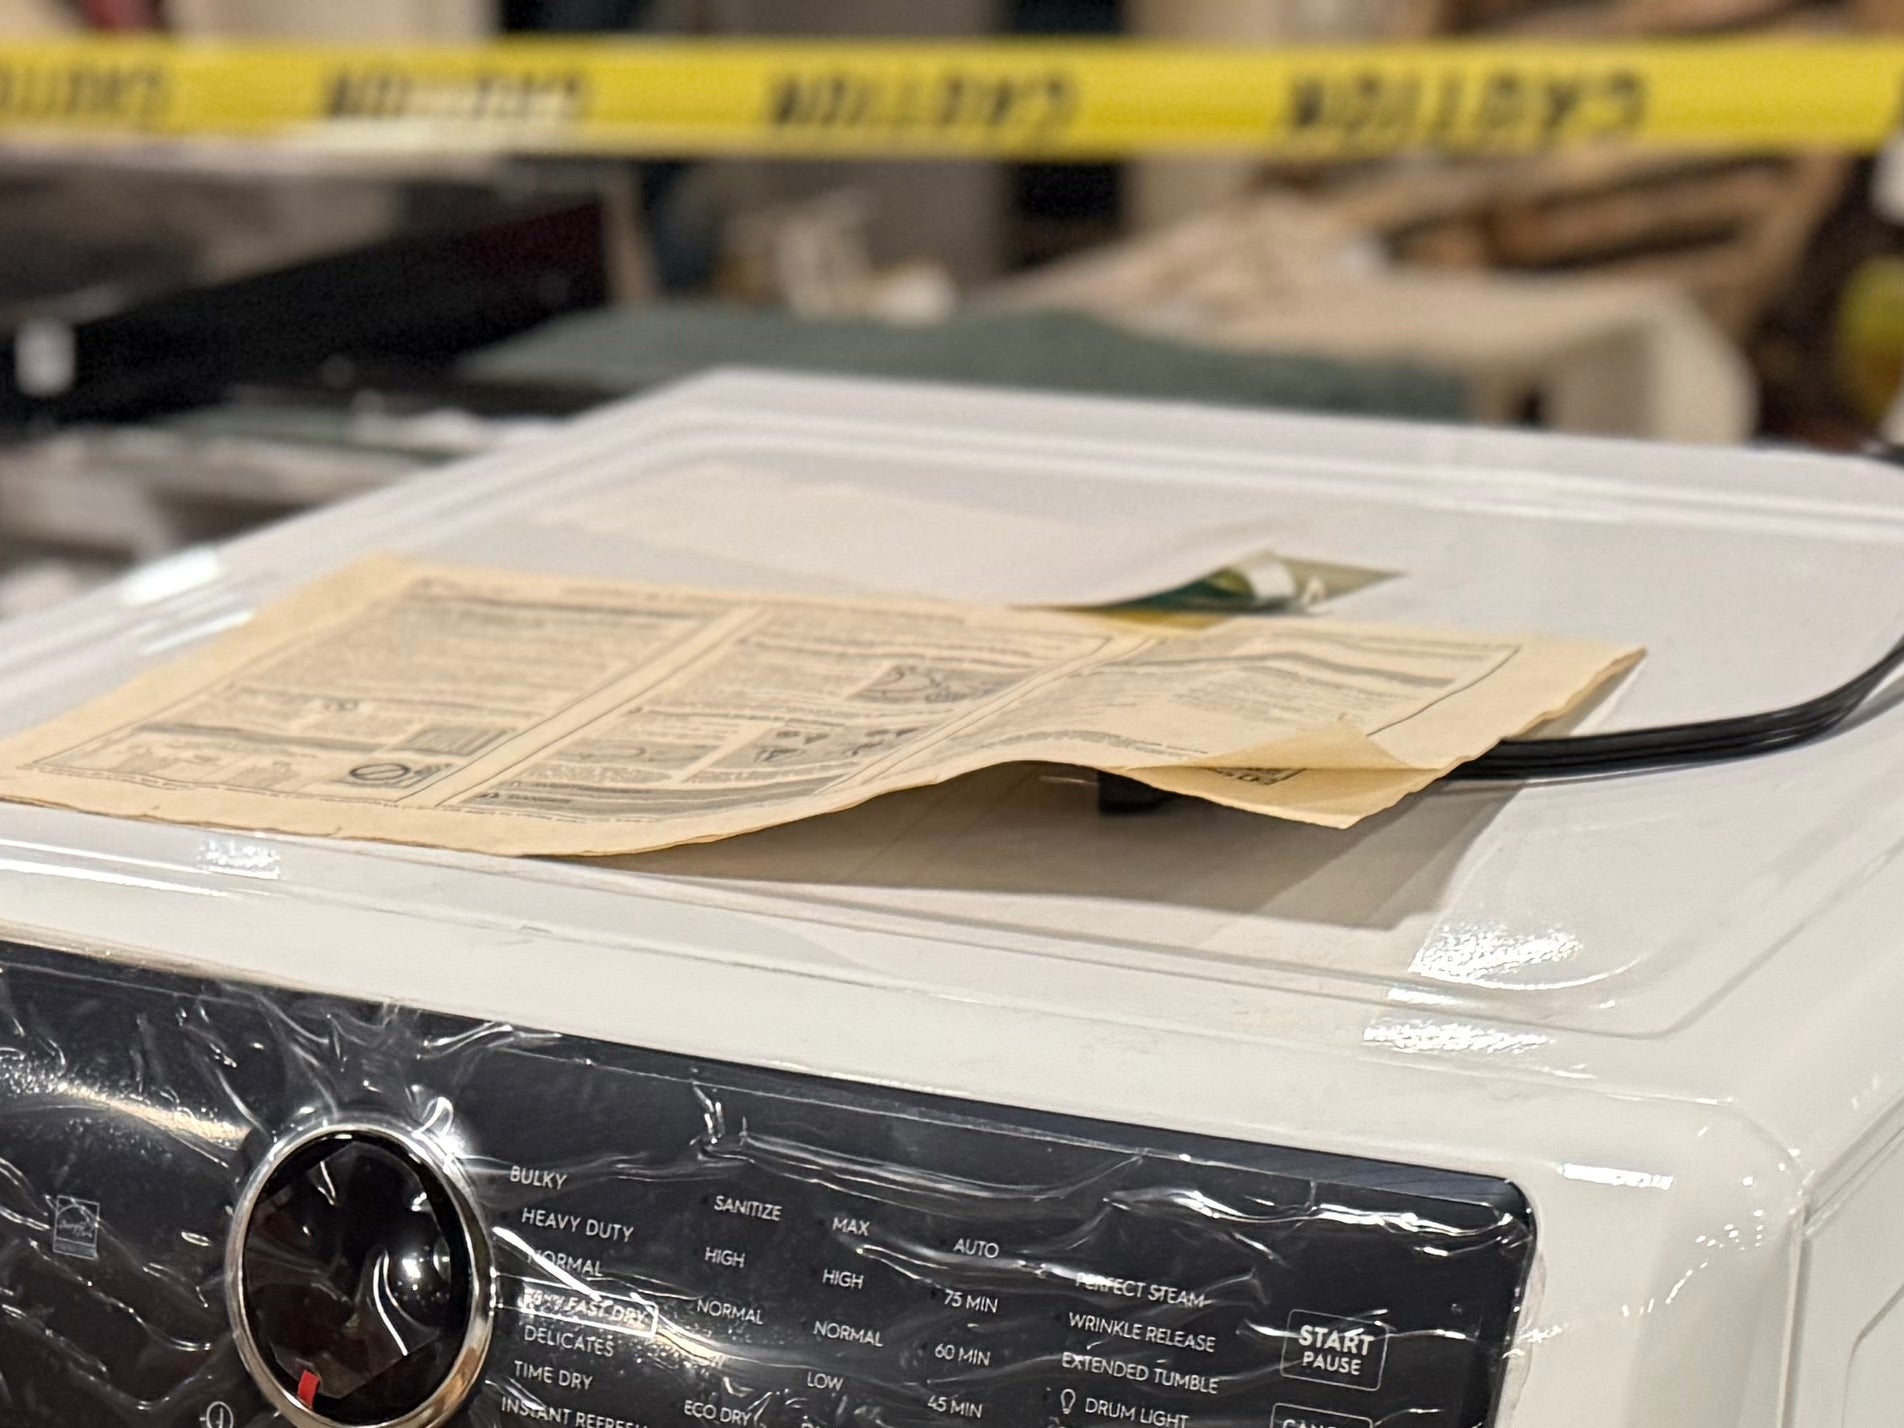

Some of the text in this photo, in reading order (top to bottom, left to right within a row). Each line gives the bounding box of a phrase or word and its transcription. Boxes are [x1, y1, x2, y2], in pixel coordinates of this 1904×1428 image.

[510, 1165, 568, 1191] BULKY
[714, 1195, 783, 1222] SANITIZE
[522, 1207, 635, 1243] HEAVY DUTY
[832, 1216, 871, 1237] MAX
[704, 1246, 746, 1269] HIGH
[952, 1238, 1000, 1259] AUTO
[822, 1268, 865, 1290] HIGH
[1074, 1272, 1206, 1309] PERFECT STEAM
[697, 1299, 764, 1326] NORMAL
[944, 1289, 999, 1314] 75 MIN
[524, 1325, 615, 1357] DELICATES
[813, 1320, 884, 1348] NORMAL
[1068, 1311, 1217, 1353] WRINKLE RELEASE
[1298, 1324, 1375, 1357] START
[934, 1343, 992, 1367] 60 MIN
[1302, 1350, 1363, 1376] PAUSE
[513, 1359, 594, 1391] TIME DRY
[807, 1371, 844, 1392] LOW
[1061, 1351, 1220, 1395] EXTENDED TUMBLE
[500, 1396, 573, 1425] INSTANT
[683, 1399, 753, 1427] ECO DRY
[927, 1395, 984, 1419] 45 MIN
[1084, 1397, 1137, 1422] DRUM
